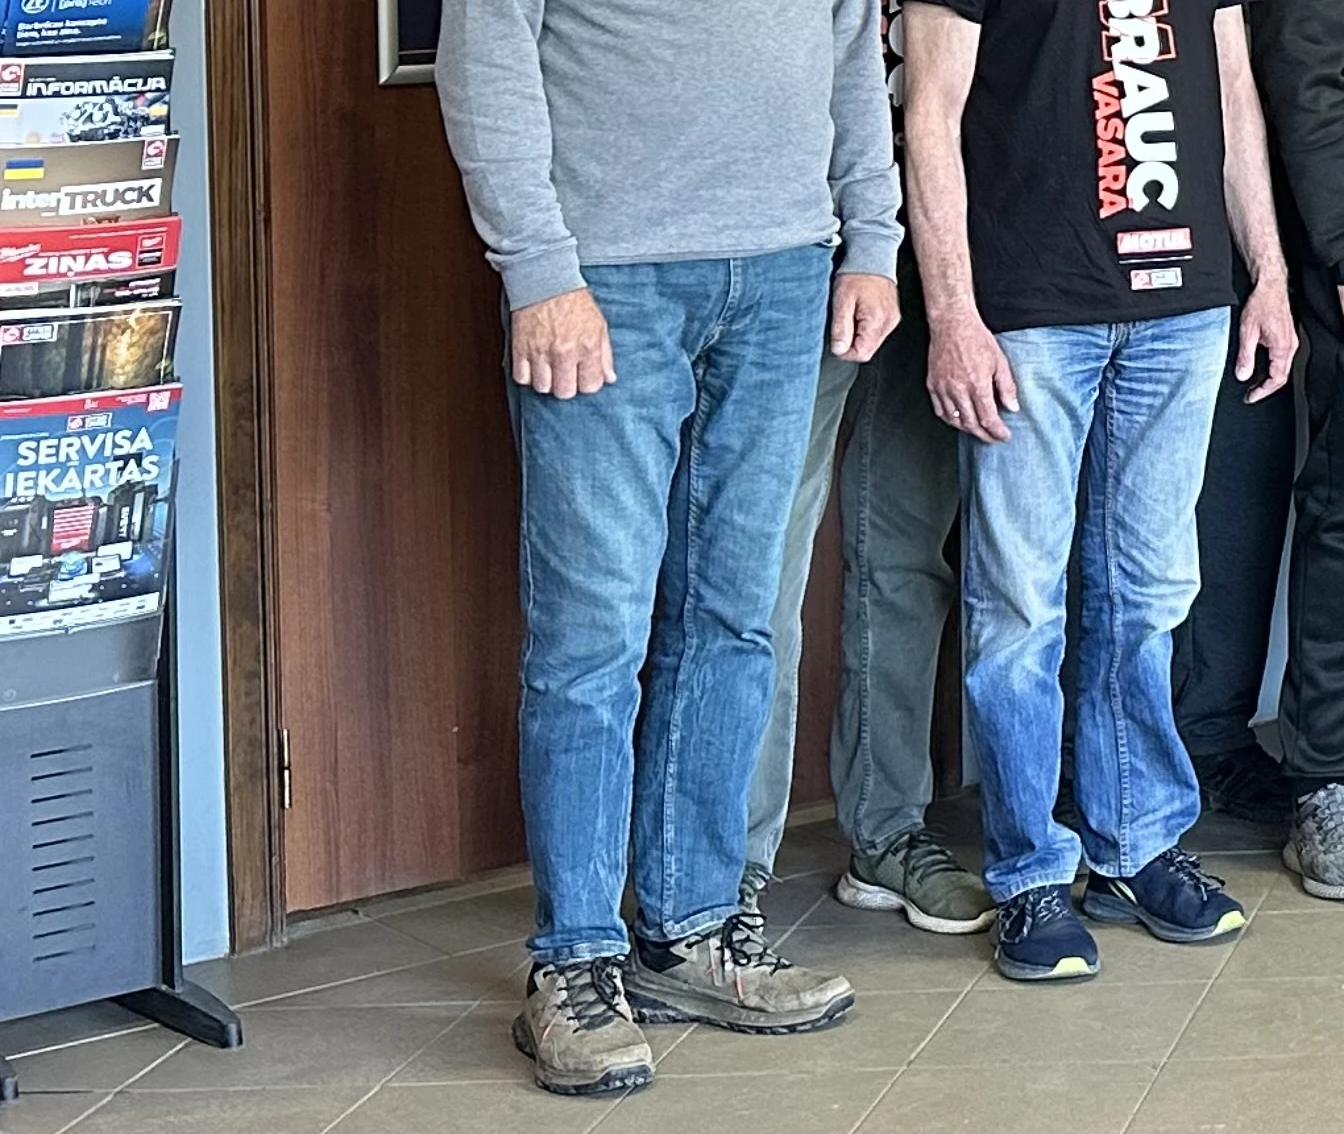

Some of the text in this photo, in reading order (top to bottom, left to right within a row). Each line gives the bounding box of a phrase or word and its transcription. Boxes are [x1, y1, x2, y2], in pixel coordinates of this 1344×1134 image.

[26, 77, 167, 96] INFORMĀCIJA
[23, 251, 133, 277] ZIŅAS
[17, 427, 153, 466] SERVISA
[5, 454, 160, 498] IEKĀRTAS
